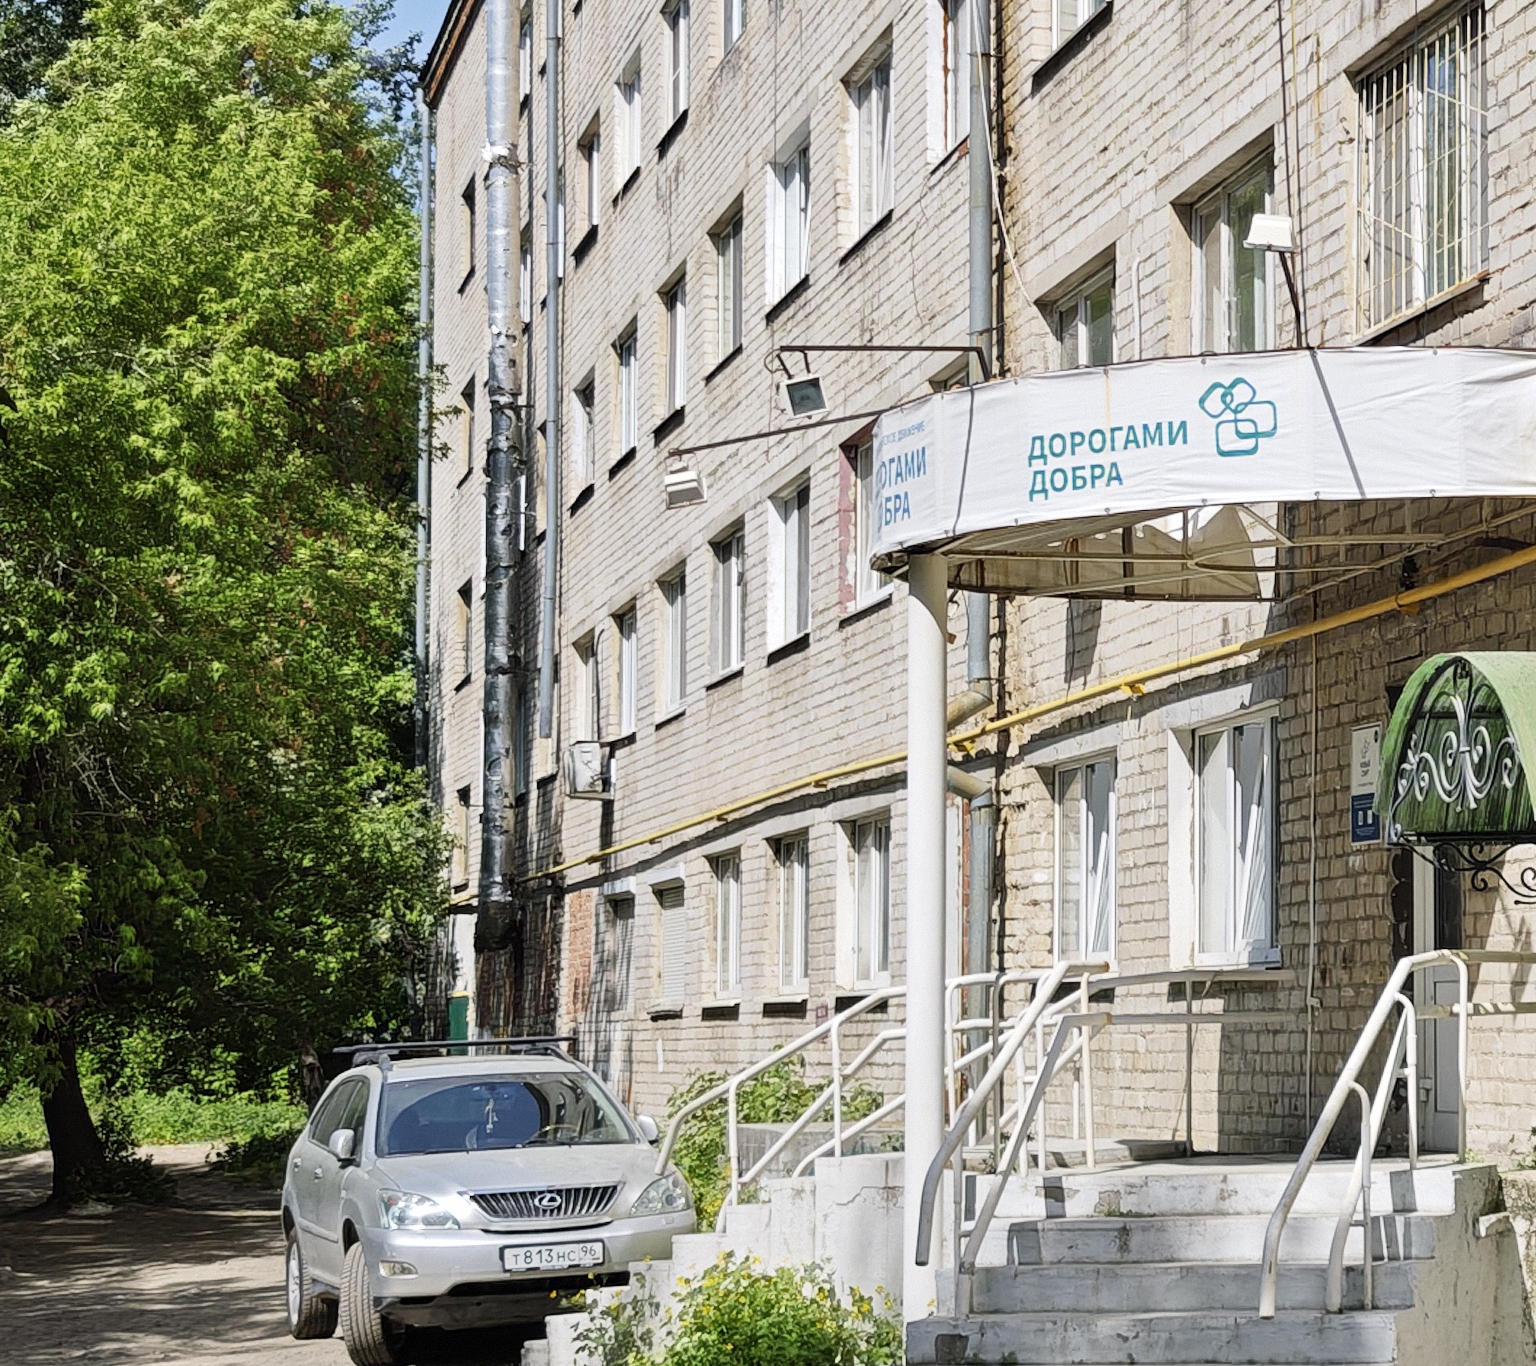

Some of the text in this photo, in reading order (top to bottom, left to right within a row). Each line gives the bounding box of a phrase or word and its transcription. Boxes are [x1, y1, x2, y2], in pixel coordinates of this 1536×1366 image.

[1027, 419, 1190, 470] ДОРОГАМИ
[1028, 461, 1124, 502] ДОБРА
[581, 1245, 597, 1257] 96
